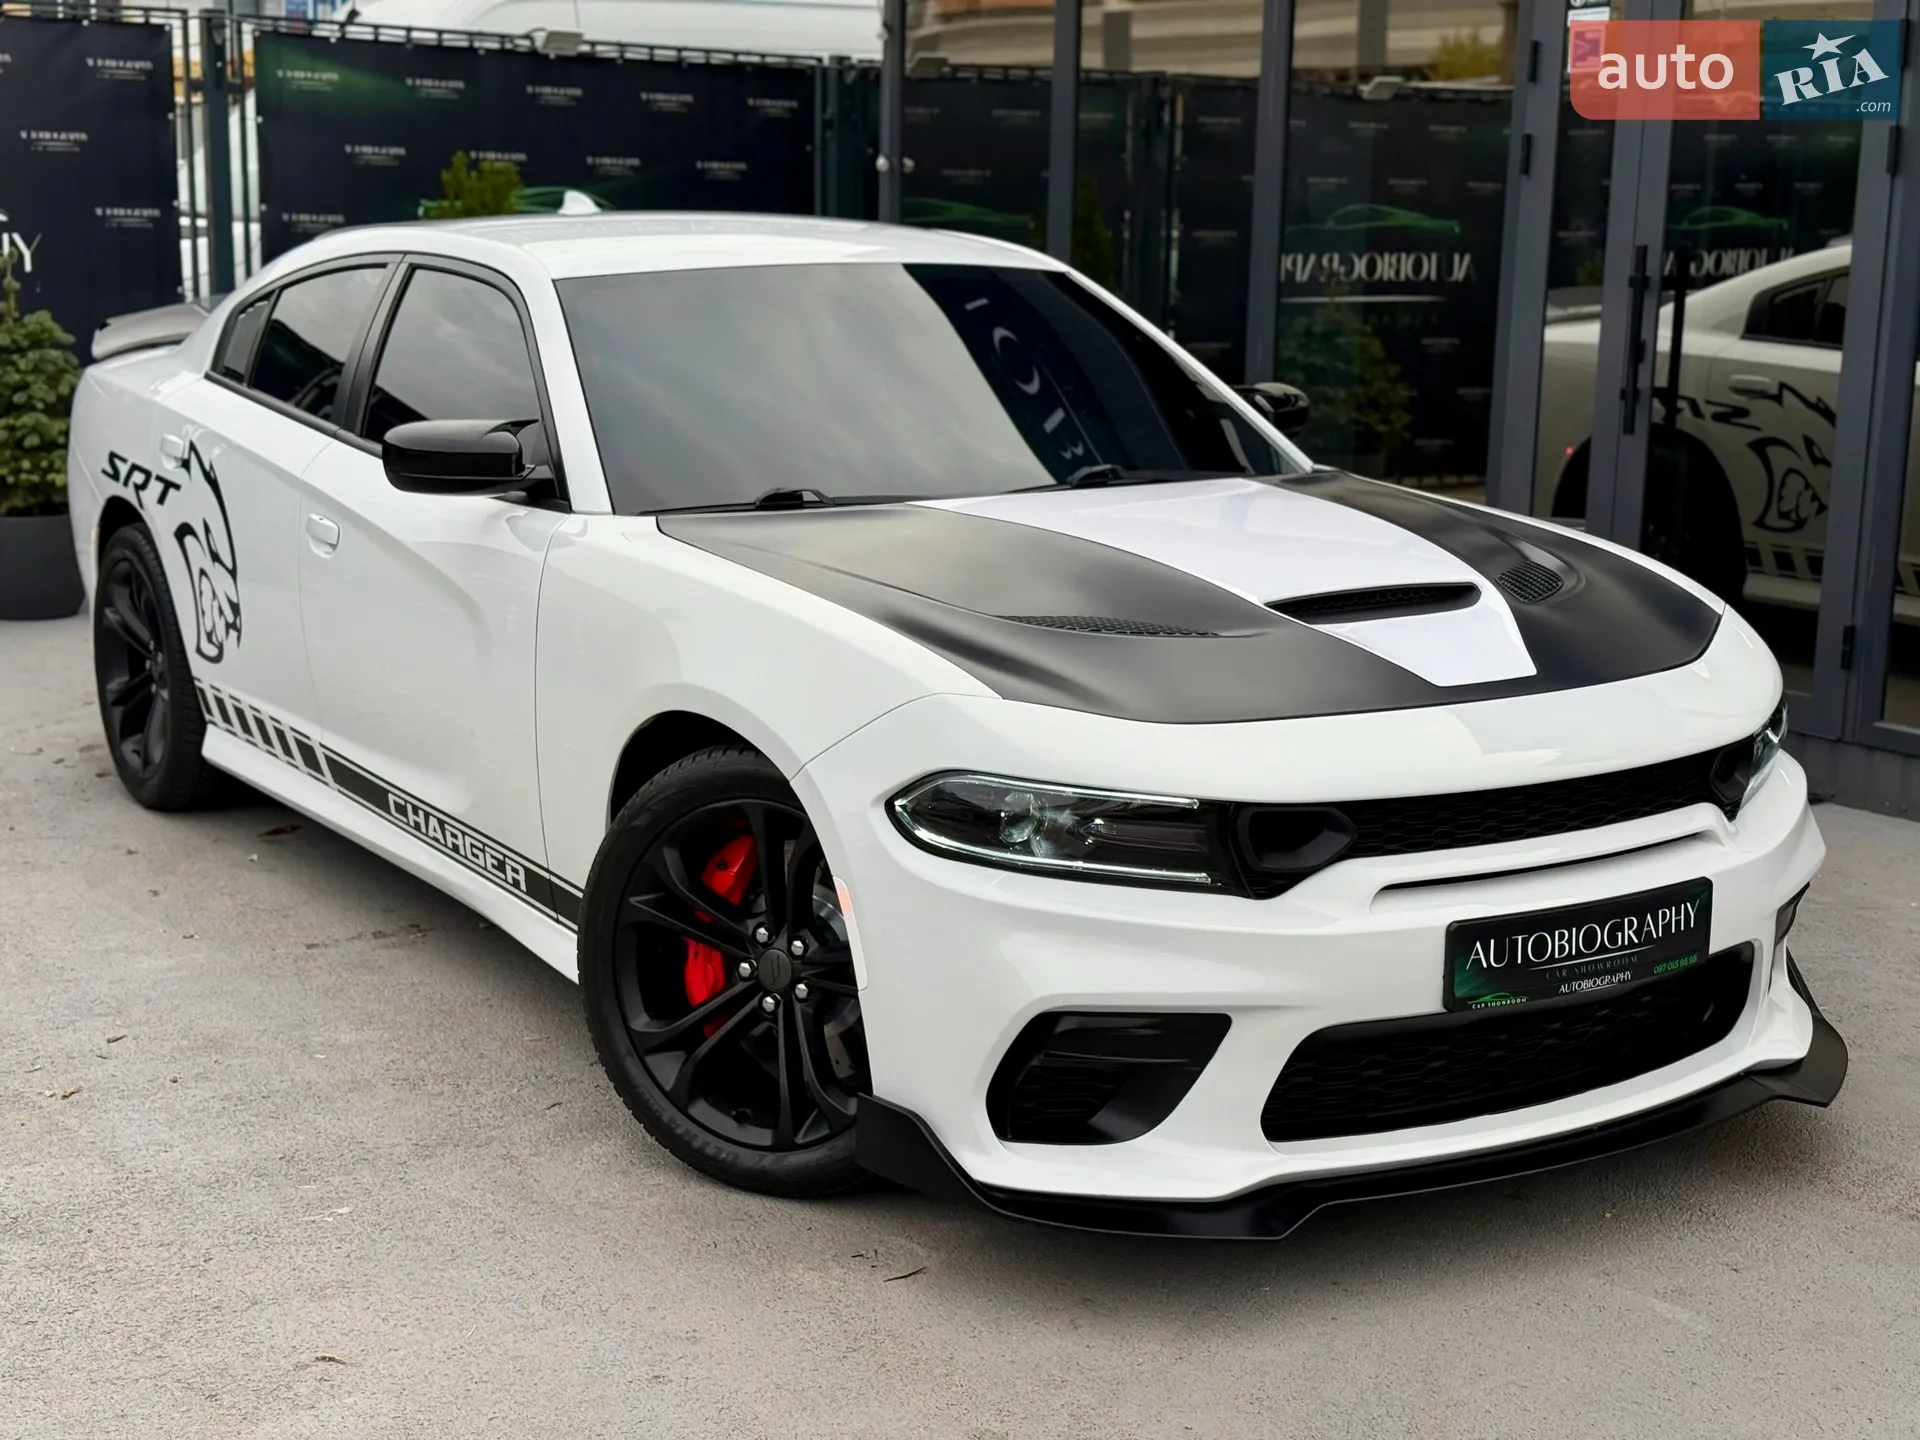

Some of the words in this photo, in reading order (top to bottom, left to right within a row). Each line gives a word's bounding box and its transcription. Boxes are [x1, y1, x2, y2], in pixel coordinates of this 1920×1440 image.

[101, 450, 182, 511] SRT
[387, 792, 527, 892] CHARGER
[1466, 899, 1700, 970] AUTOBIOGRAPHY
[1574, 955, 1638, 975] SHOWROOM
[1558, 970, 1633, 994] AUTOBIOGRAPHY
